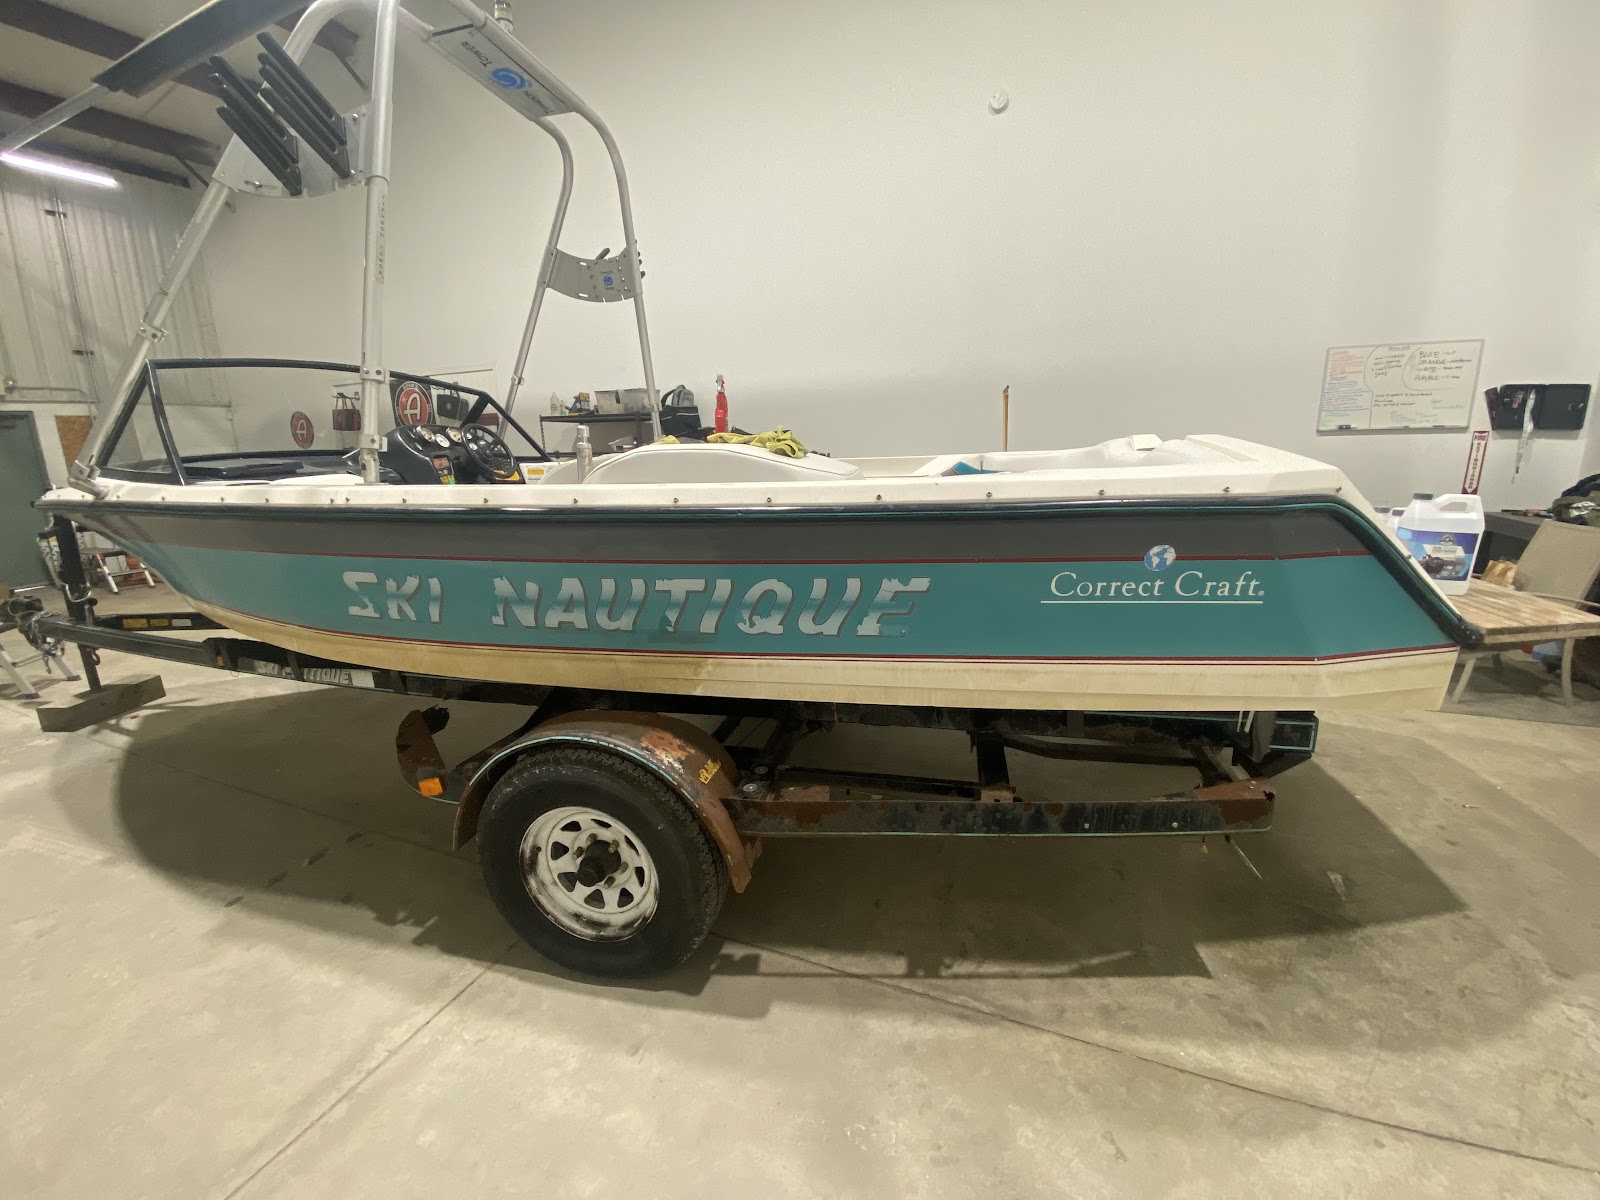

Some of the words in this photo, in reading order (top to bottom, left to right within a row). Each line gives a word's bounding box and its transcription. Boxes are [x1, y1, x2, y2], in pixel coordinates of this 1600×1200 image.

[341, 571, 444, 623] SKI
[491, 576, 931, 637] NAUTIQUE
[1050, 571, 1165, 597] Correct
